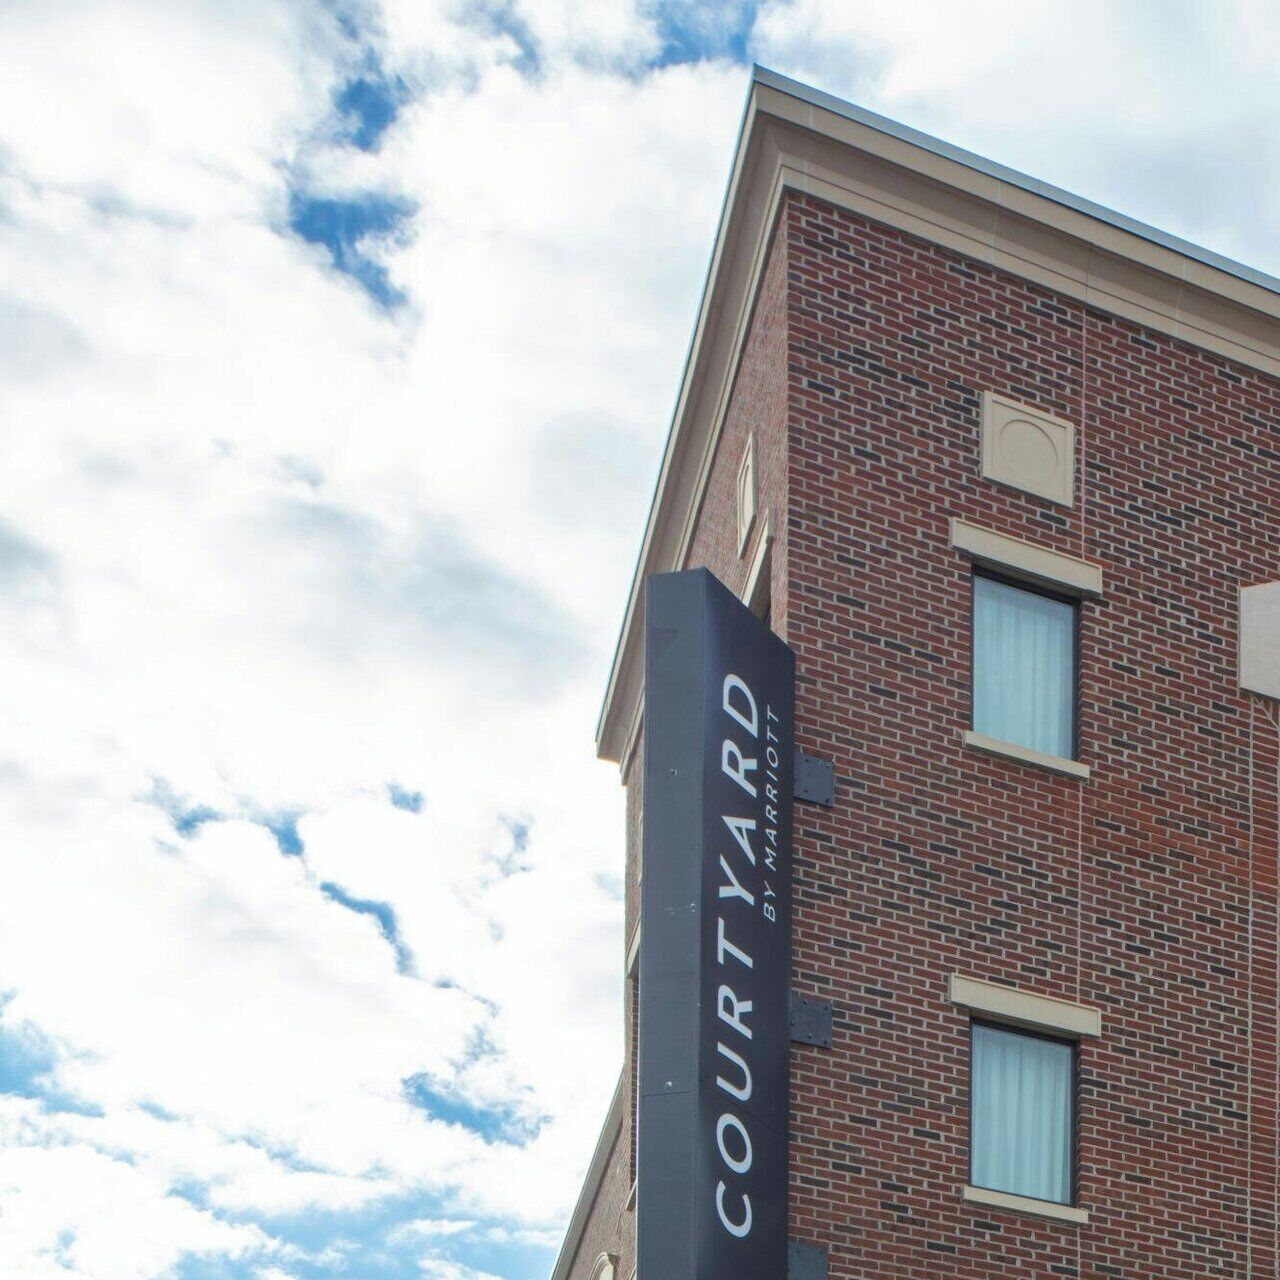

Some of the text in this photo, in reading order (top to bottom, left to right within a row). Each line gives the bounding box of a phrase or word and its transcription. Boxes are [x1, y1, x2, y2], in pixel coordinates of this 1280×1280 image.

[715, 673, 759, 1238] COURTYARD
[763, 705, 779, 922] BY MARRIOTT
